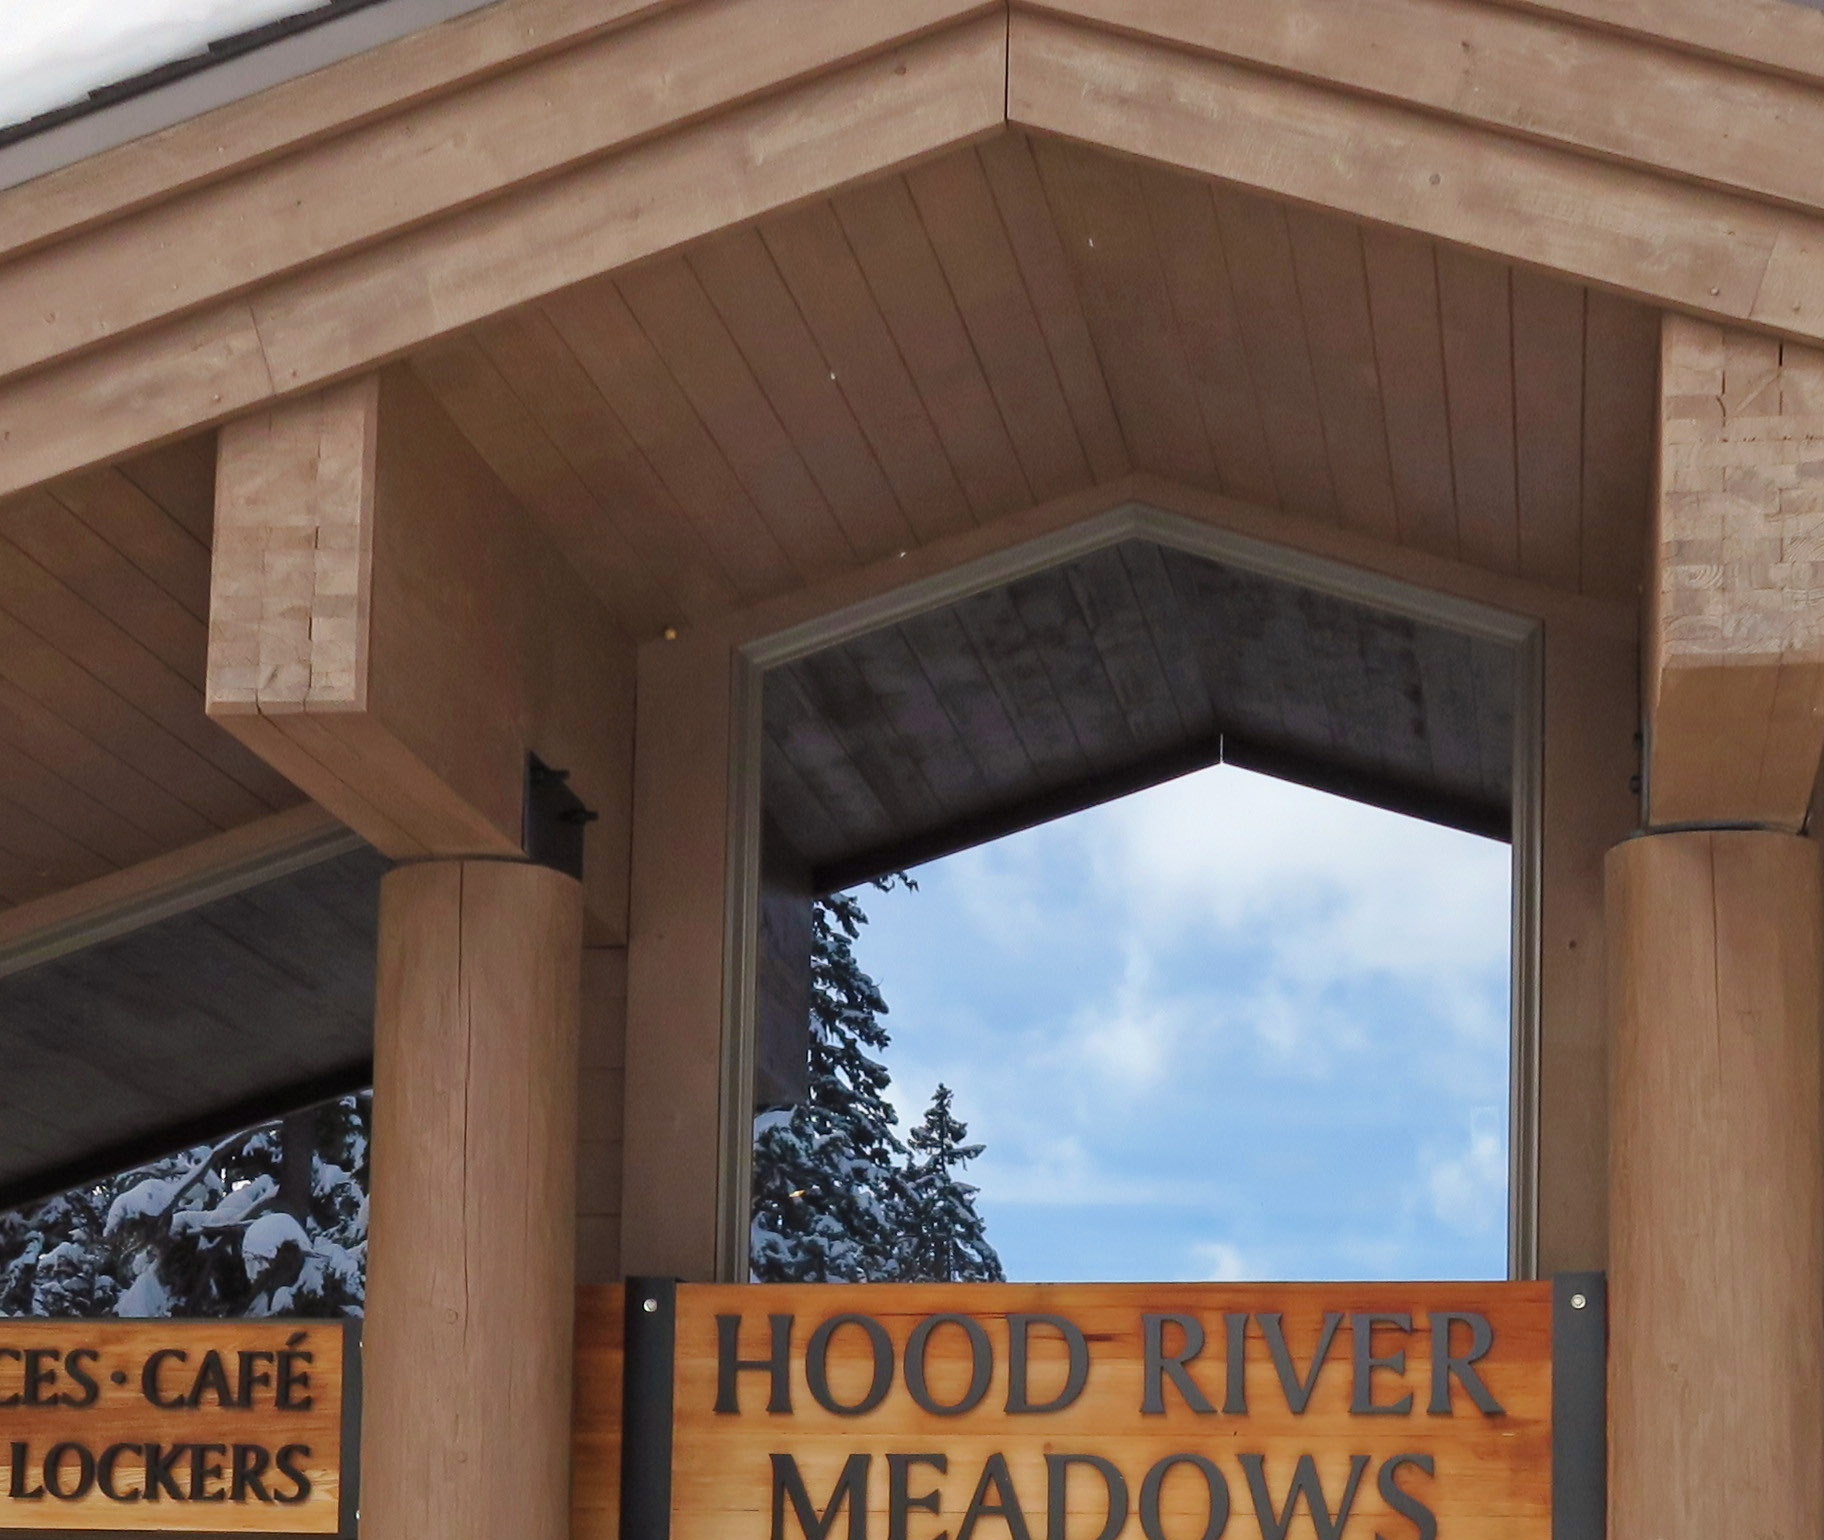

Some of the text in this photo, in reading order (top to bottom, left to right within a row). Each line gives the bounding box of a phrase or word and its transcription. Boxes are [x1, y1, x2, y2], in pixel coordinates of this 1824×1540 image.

[140, 1331, 314, 1412] CAFÉ
[711, 1311, 1507, 1418] HOOD RIVER
[8, 1440, 314, 1504] LOCKERS
